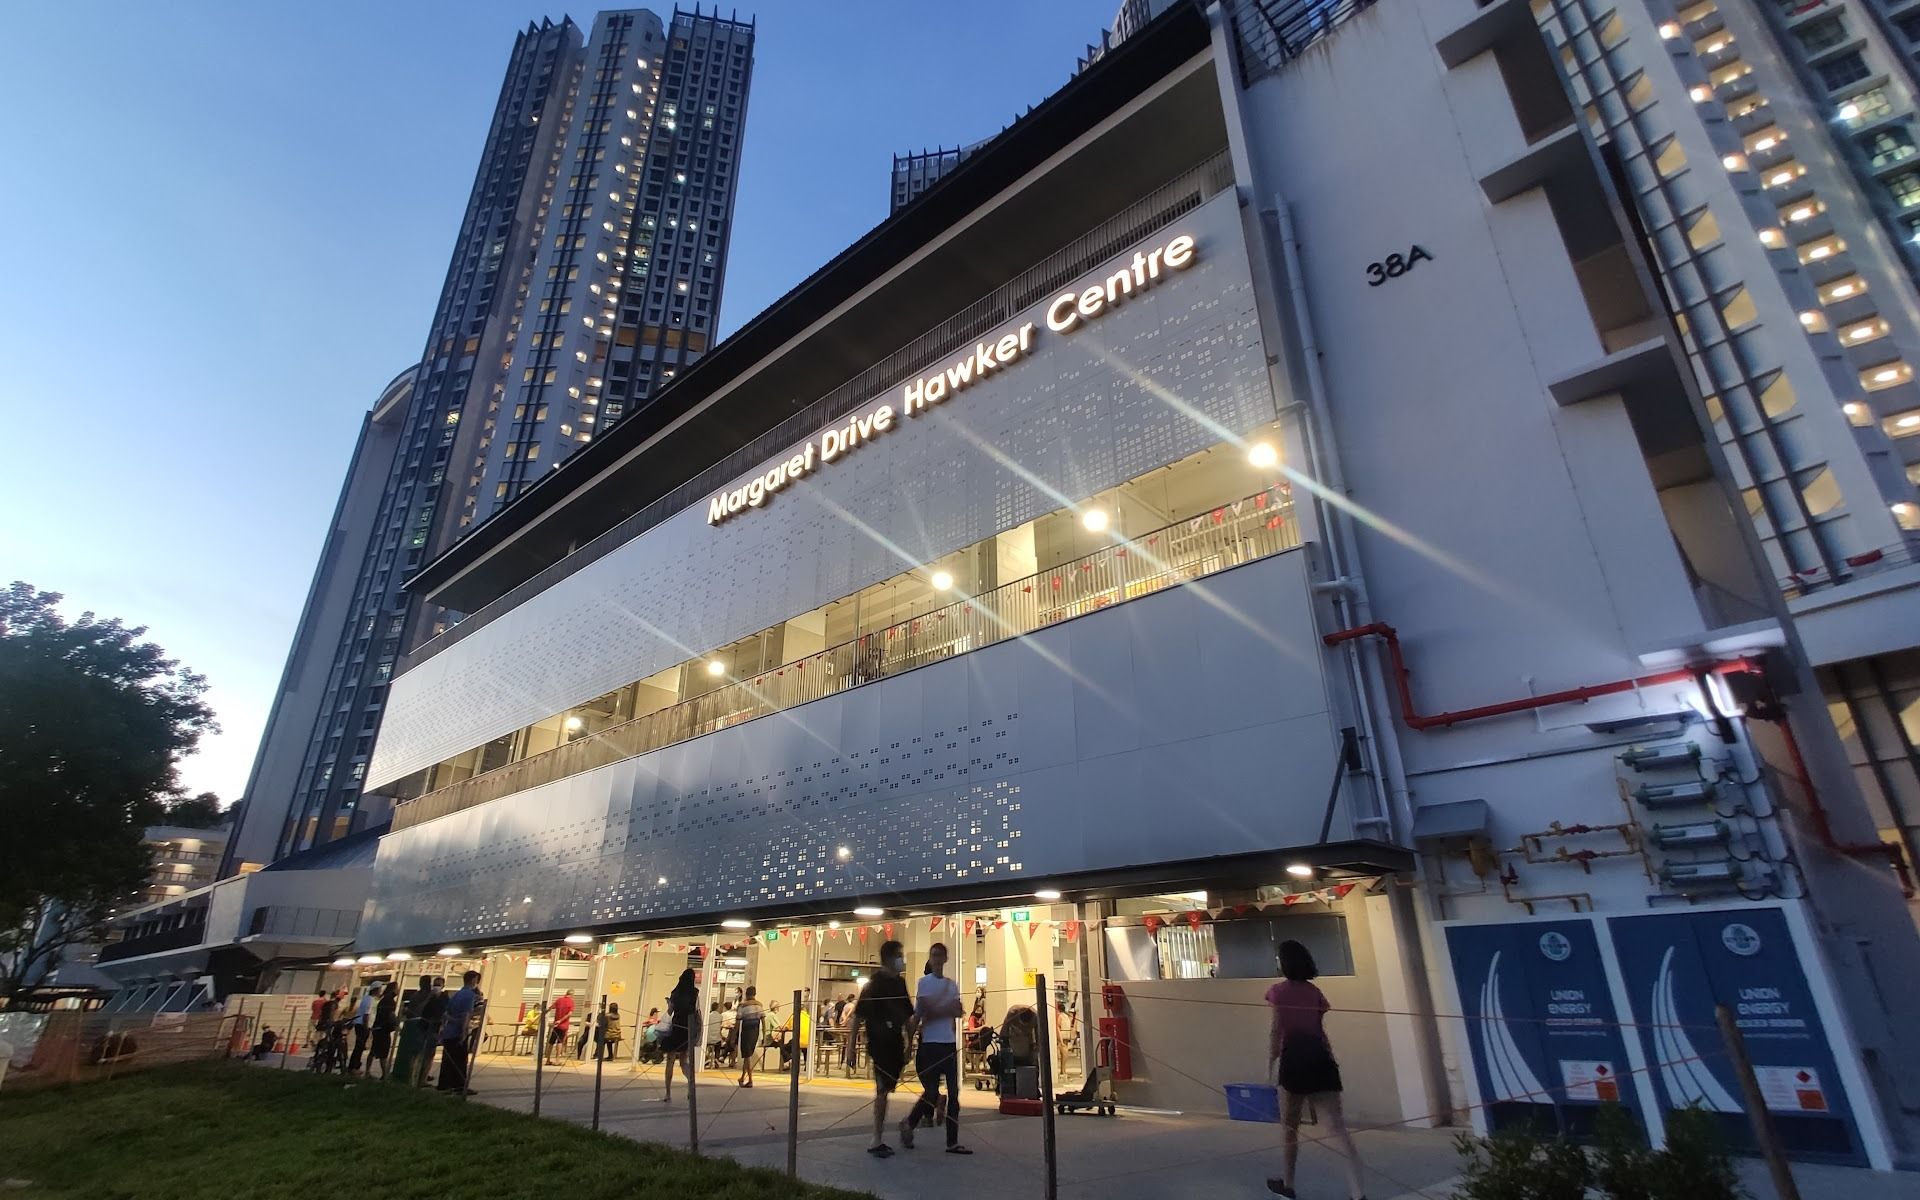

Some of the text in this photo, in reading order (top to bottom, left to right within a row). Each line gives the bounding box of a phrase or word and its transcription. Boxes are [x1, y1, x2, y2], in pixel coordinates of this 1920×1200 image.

[1366, 245, 1432, 287] 38A
[707, 234, 1195, 525] Margaret Drive Hawker Centre
[1550, 990, 1584, 1001] UNION
[1739, 988, 1779, 1000] UNION
[1547, 1003, 1591, 1014] ENERGY
[1737, 1002, 1790, 1015] ENERGY
